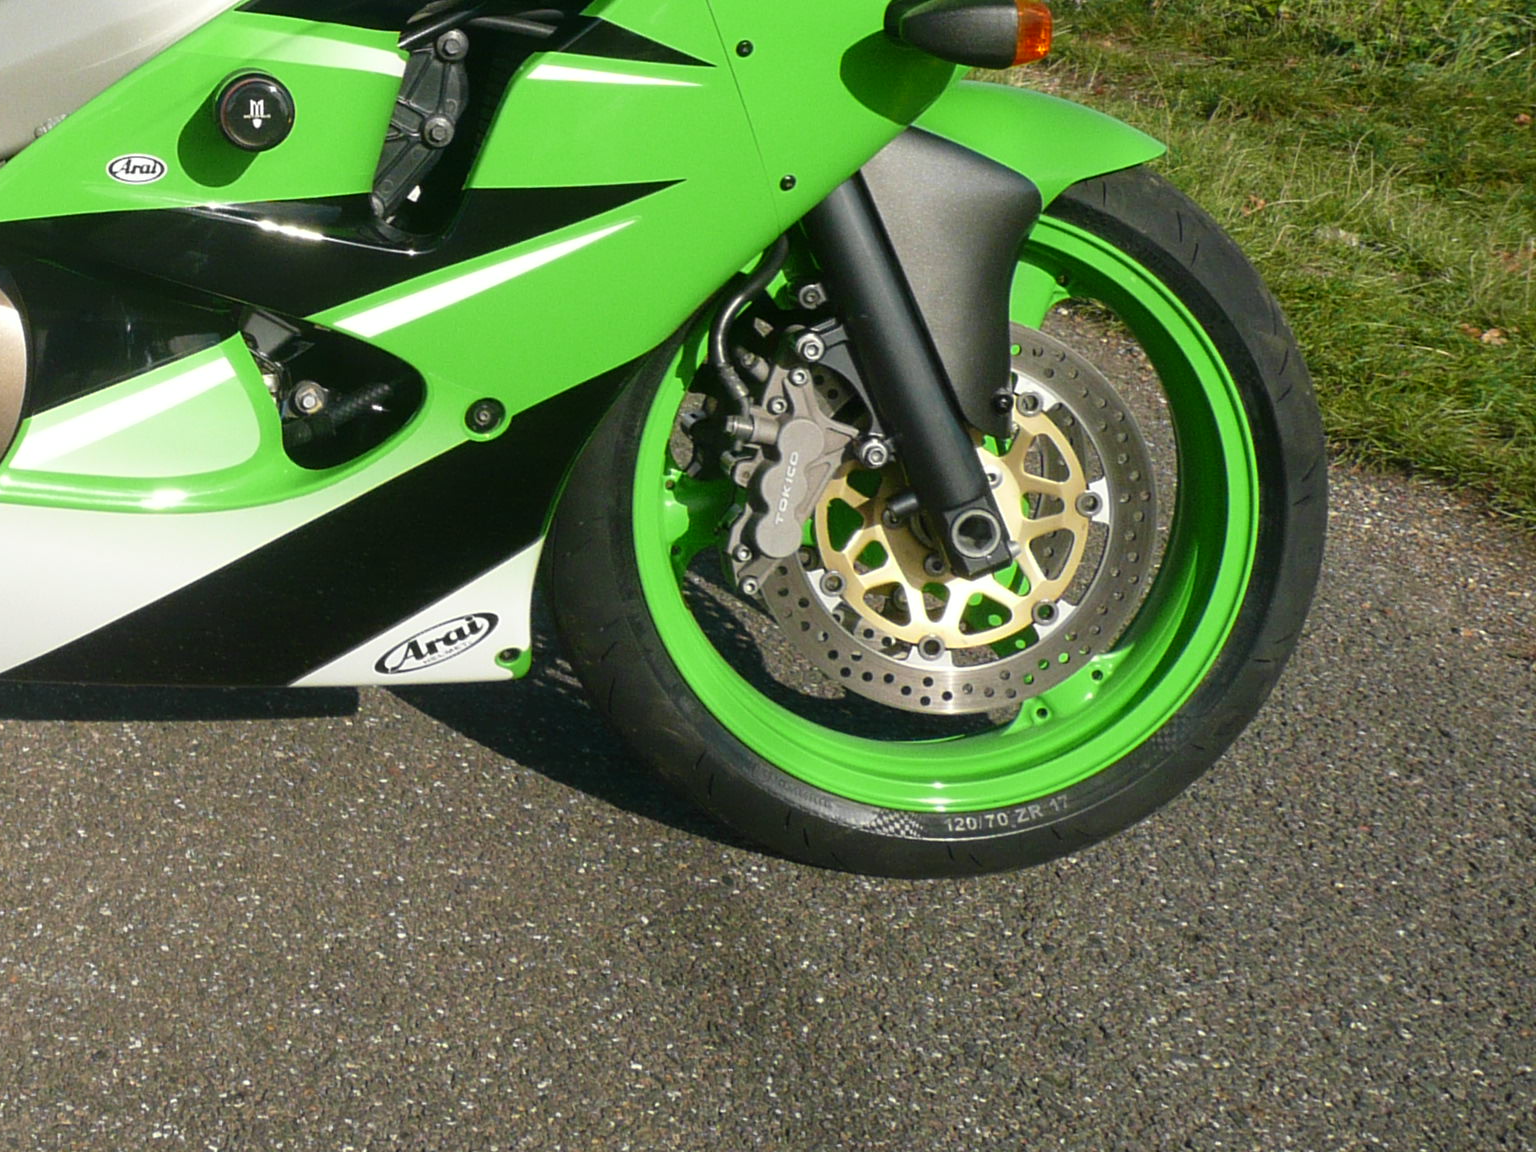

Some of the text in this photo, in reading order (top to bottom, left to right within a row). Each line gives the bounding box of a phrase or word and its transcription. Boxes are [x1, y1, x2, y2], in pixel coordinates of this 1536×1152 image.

[775, 451, 799, 525] TOKICO
[390, 615, 484, 672] Arai
[944, 794, 1069, 832] 120/70 ZR 17
